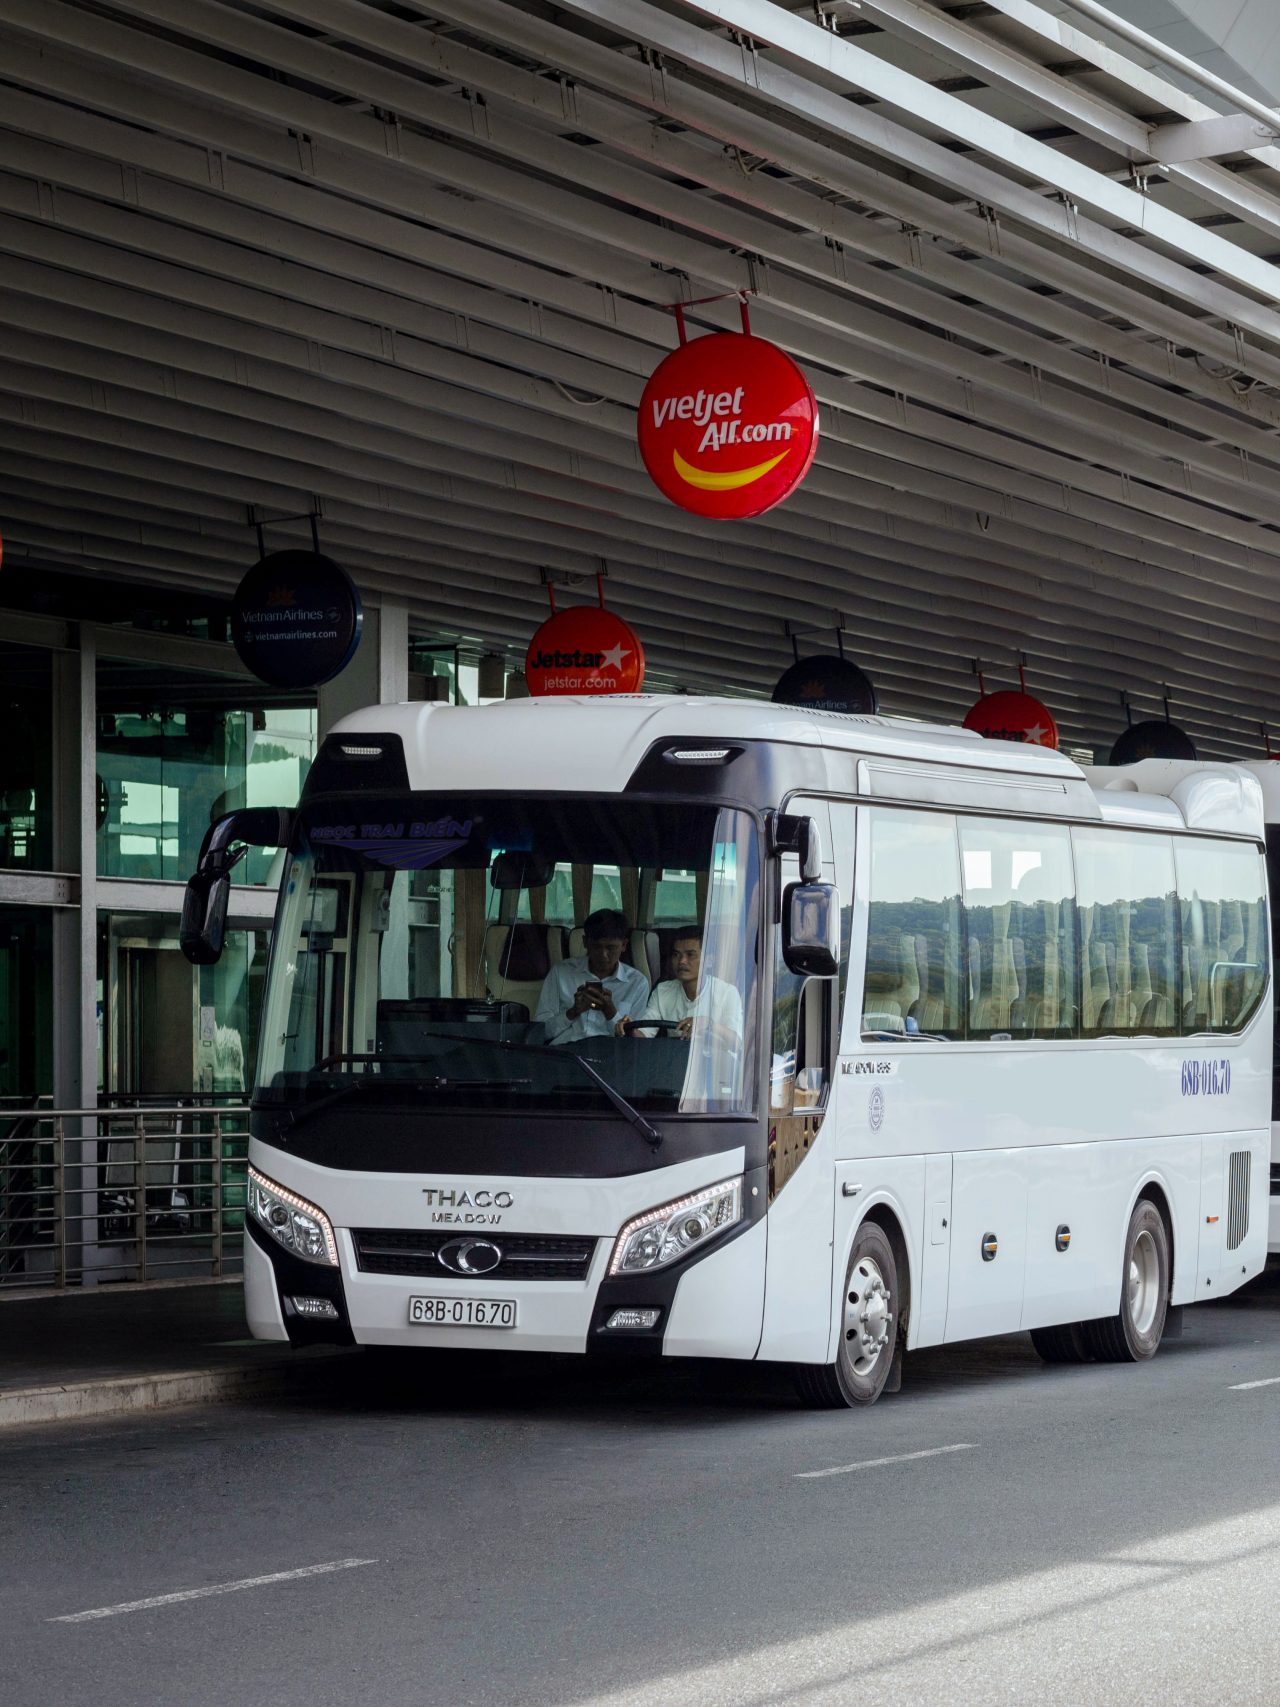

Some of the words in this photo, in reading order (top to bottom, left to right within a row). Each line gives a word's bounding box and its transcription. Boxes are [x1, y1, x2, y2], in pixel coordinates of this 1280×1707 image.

[653, 387, 745, 428] Vietjet
[697, 420, 792, 452] Air.com
[255, 630, 337, 641] vietnamairlines.com
[531, 649, 604, 669] Jetstar
[544, 676, 617, 691] jetstar.com
[360, 823, 405, 839] TRAI
[1181, 1059, 1231, 1096] 68B-016.70
[422, 1188, 514, 1209] THACO
[432, 1212, 502, 1225] MEADOW
[413, 1300, 512, 1324] 68B-016.70
